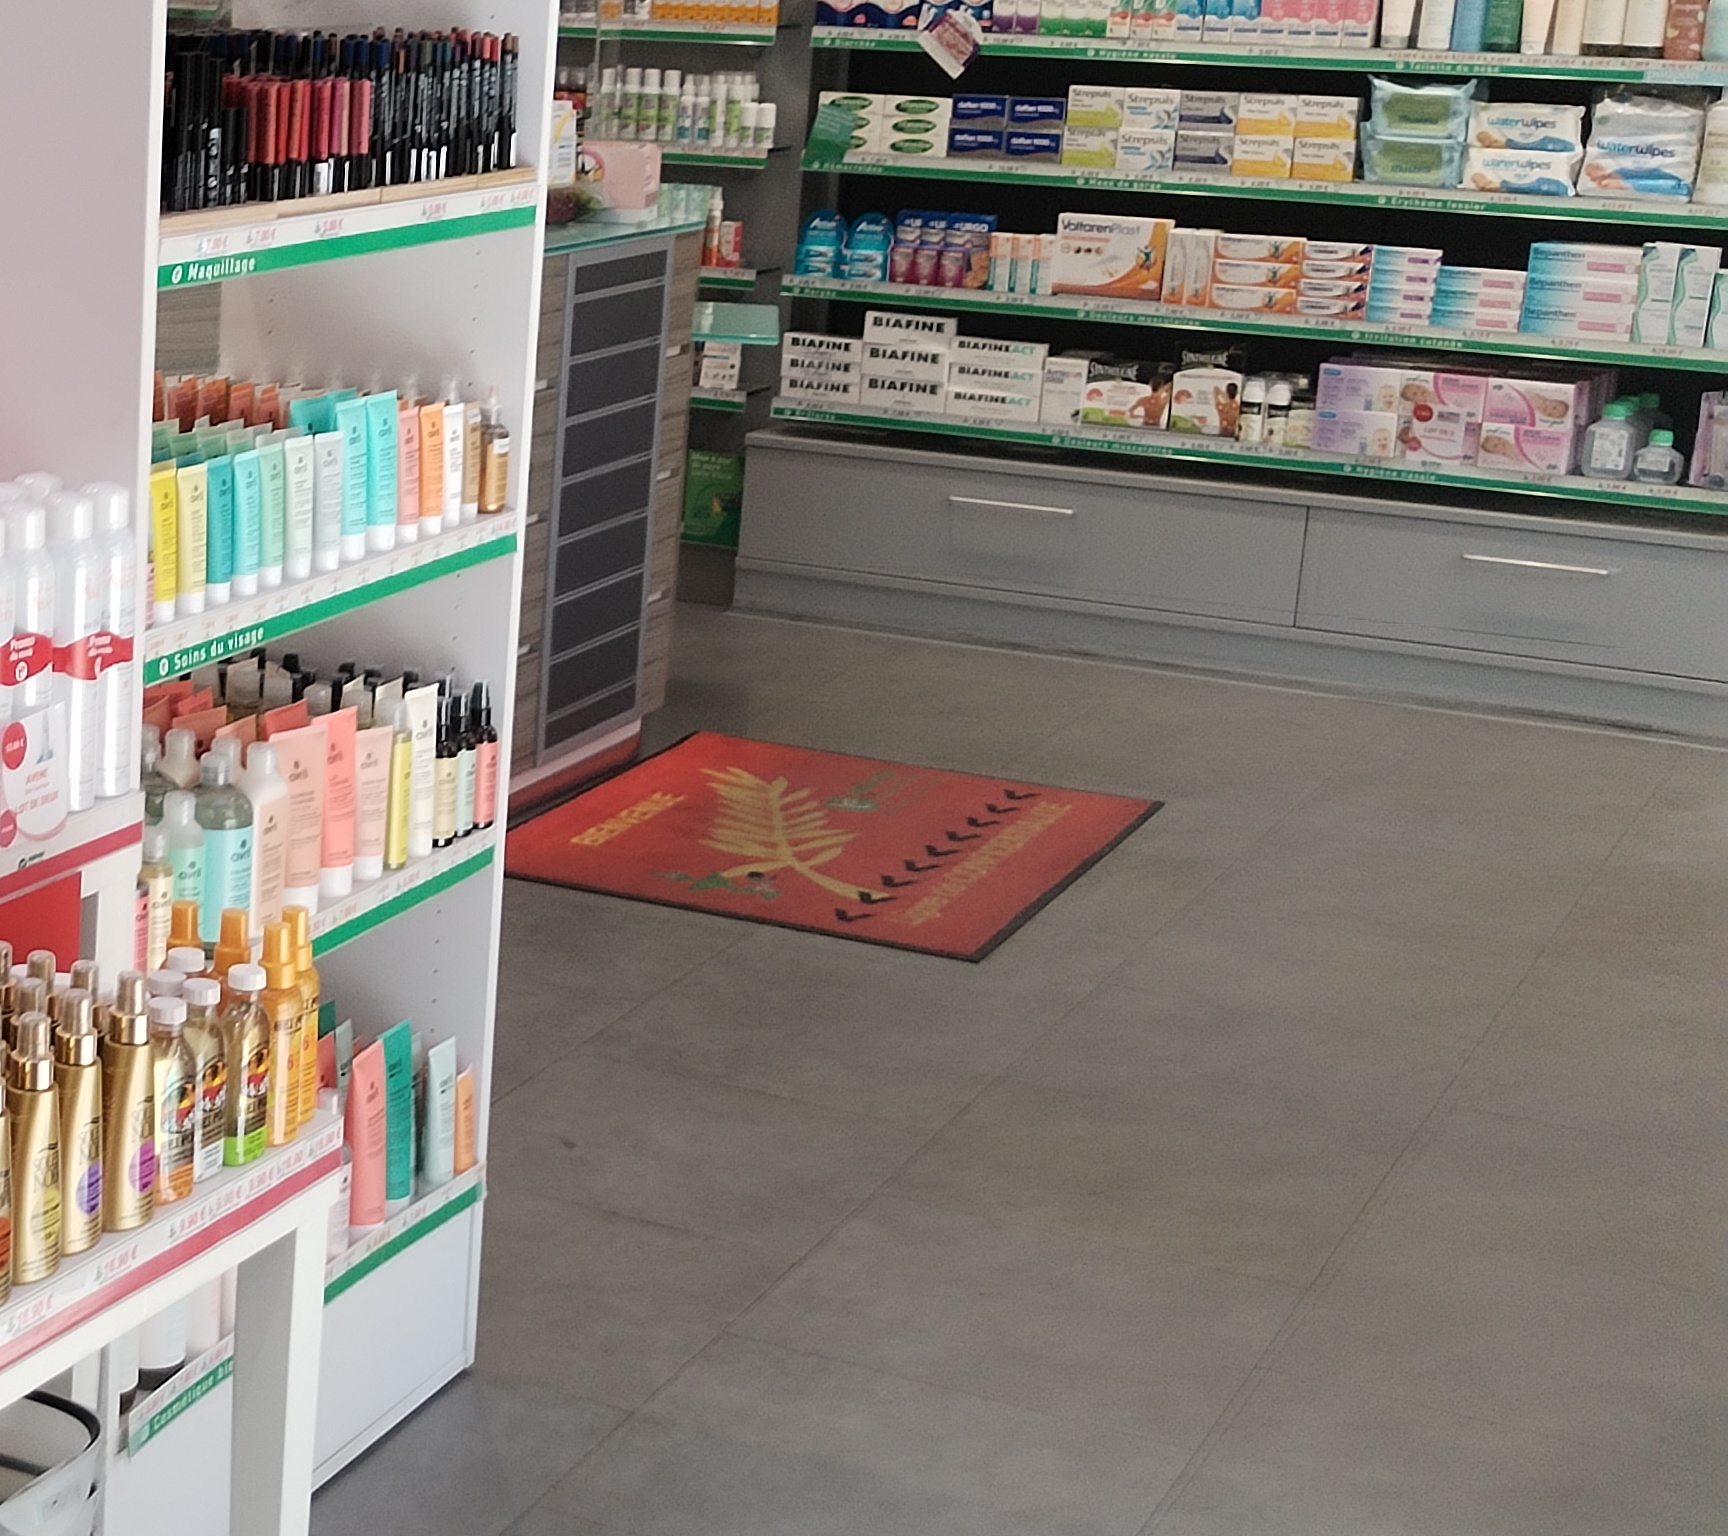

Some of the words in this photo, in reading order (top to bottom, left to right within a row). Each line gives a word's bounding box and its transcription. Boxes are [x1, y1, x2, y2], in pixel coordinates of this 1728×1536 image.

[1487, 116, 1556, 131] waterwipes
[1597, 140, 1675, 159] waterwipes
[1483, 157, 1551, 171] waterwipes
[188, 255, 256, 283] Maquillage
[872, 317, 945, 334] BIAFINE
[791, 337, 851, 352] BIAFINE
[870, 347, 939, 365] BIAFINE
[790, 358, 851, 373] BIAFINE
[788, 378, 850, 394] BIAFINE
[868, 378, 938, 395] BIAFINE
[174, 645, 206, 670] Soins
[210, 640, 224, 660] du
[228, 627, 264, 653] visage
